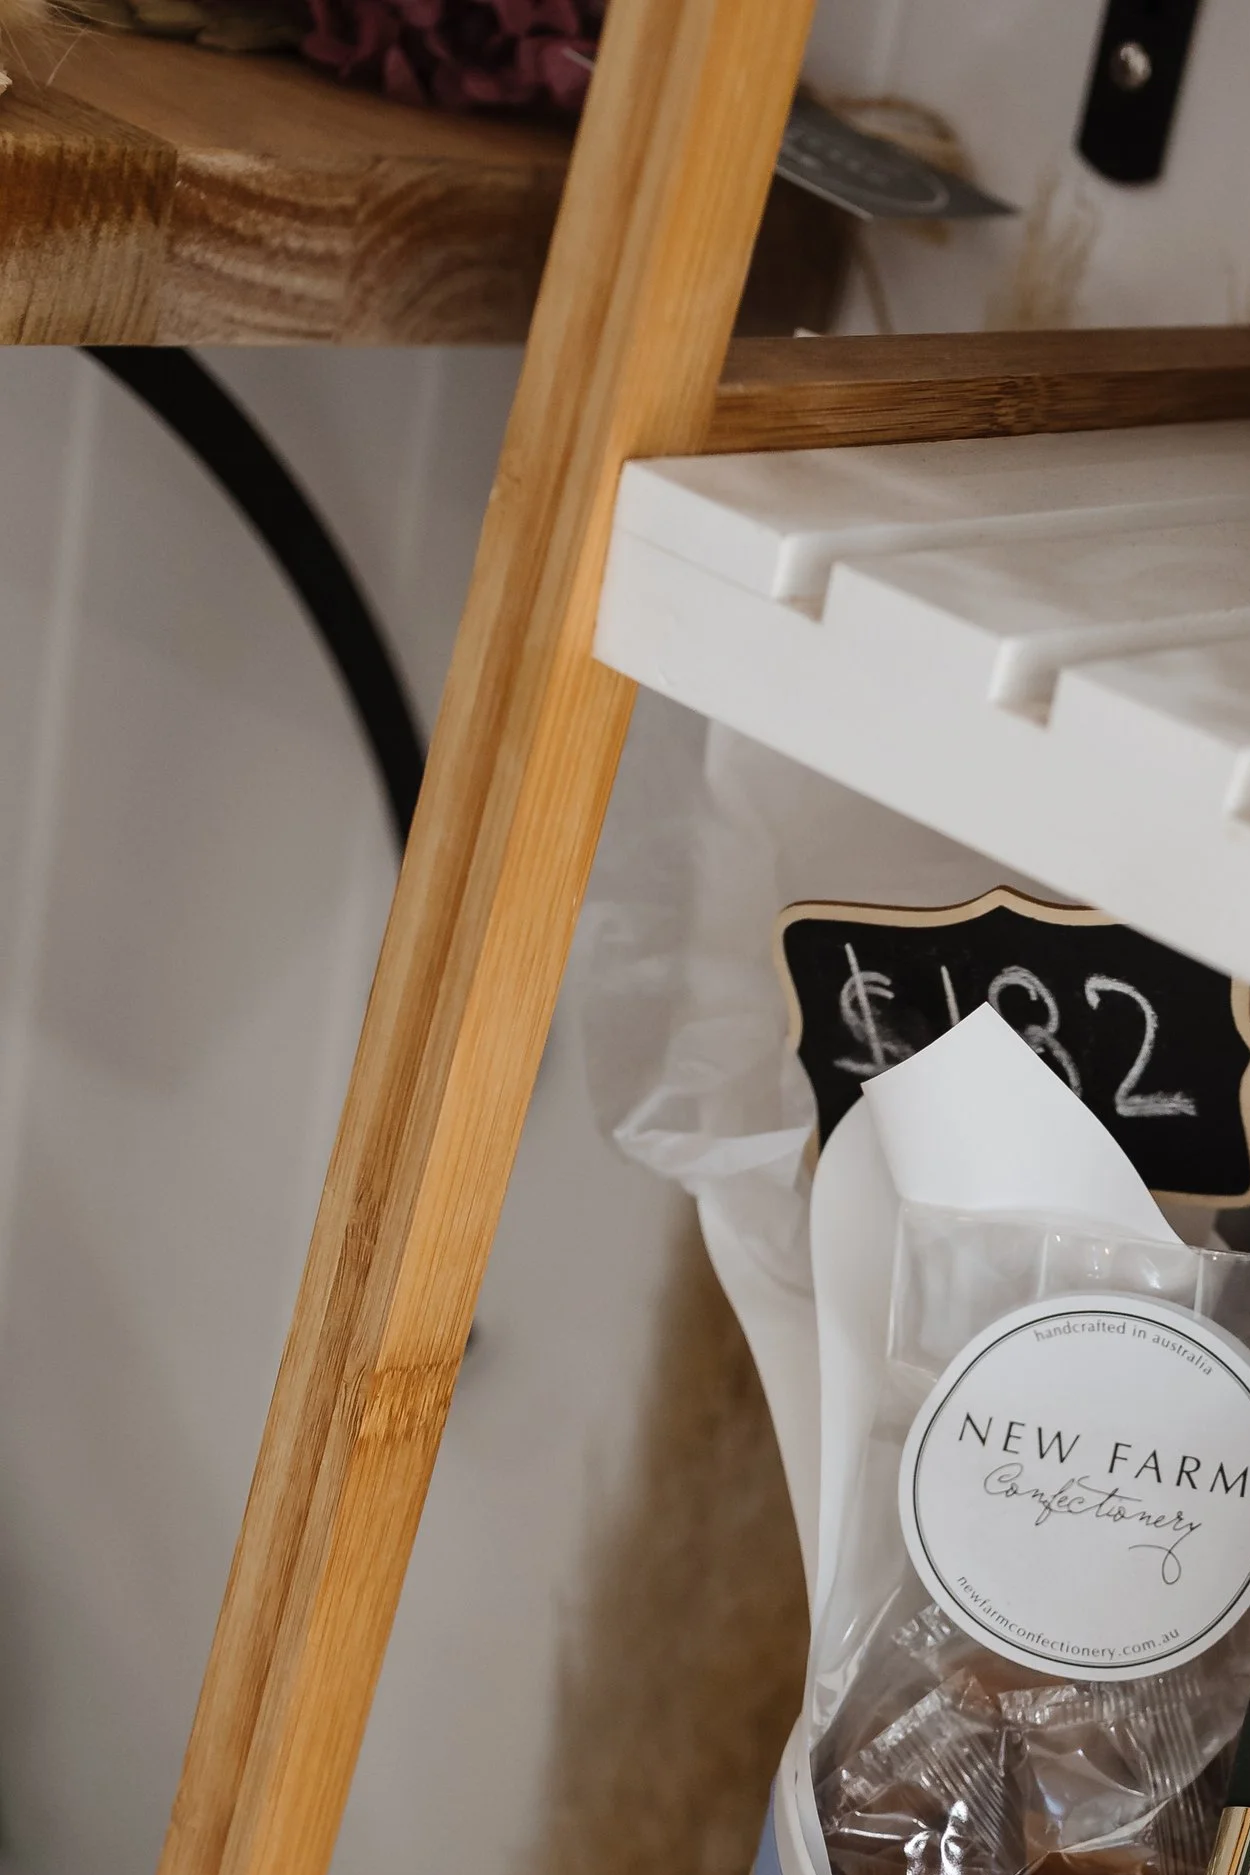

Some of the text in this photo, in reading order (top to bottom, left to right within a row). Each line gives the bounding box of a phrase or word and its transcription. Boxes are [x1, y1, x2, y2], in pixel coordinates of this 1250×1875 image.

[1033, 1319, 1214, 1376] handcrafted in australia
[958, 1412, 1249, 1498] NEW FARM
[983, 1462, 1202, 1585] Confectionery
[956, 1576, 1180, 1661] newfarmconfectionery.com.au
